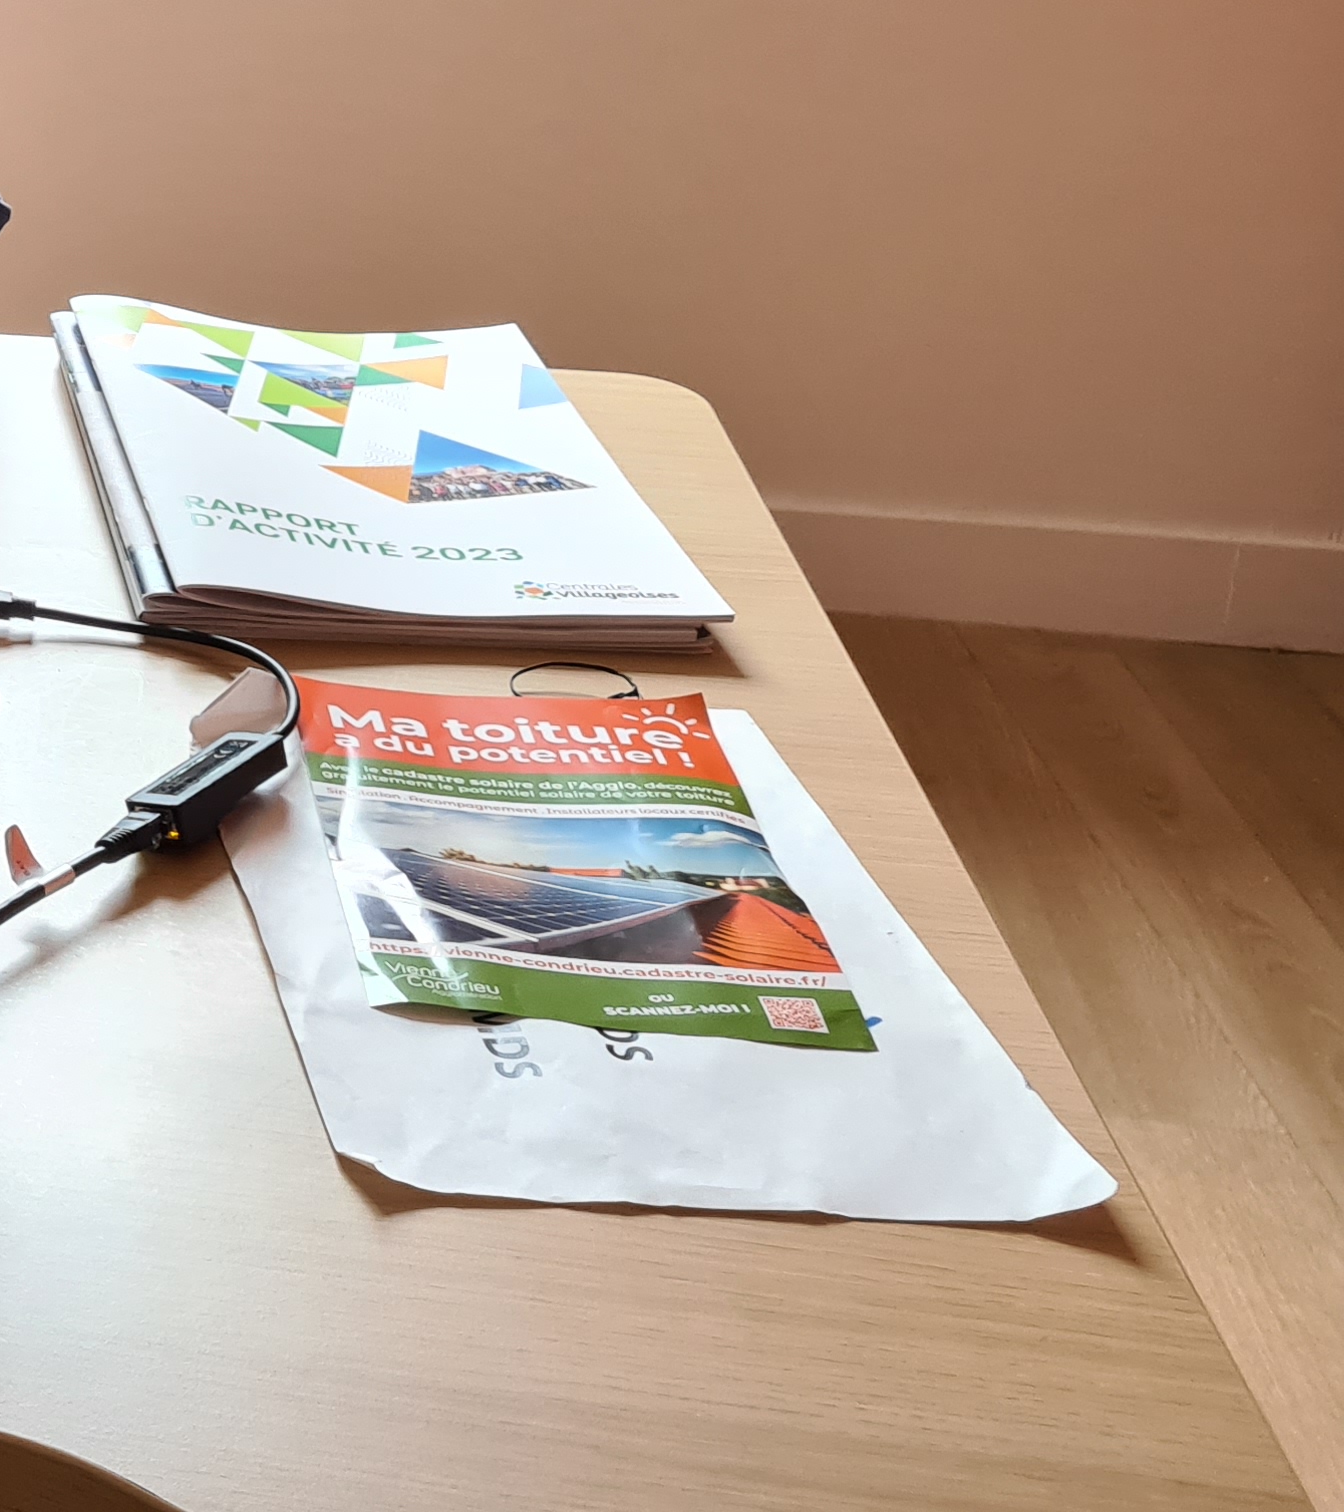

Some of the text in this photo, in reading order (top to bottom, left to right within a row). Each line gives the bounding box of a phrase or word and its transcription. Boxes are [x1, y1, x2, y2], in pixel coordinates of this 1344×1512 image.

[185, 494, 360, 536] RAPPORT
[190, 512, 525, 562] D'ACTIVITÉ 2023
[326, 704, 684, 750] Ma toiture
[333, 732, 696, 769] a du potentiel !
[319, 761, 358, 773] Ave
[381, 767, 466, 785] cadastre
[468, 778, 534, 790] solaire
[538, 781, 564, 790] de
[643, 781, 733, 799] découvrez
[321, 770, 735, 806] grauitement le potentiel solaire de votre toiture
[408, 794, 539, 815] Accompagnement
[546, 806, 637, 816] Installateurs
[384, 960, 457, 979] Vienn
[406, 973, 500, 996] Condrieu
[602, 1003, 742, 1018] SCANNEZ-MOI
[647, 993, 675, 1005] OU
